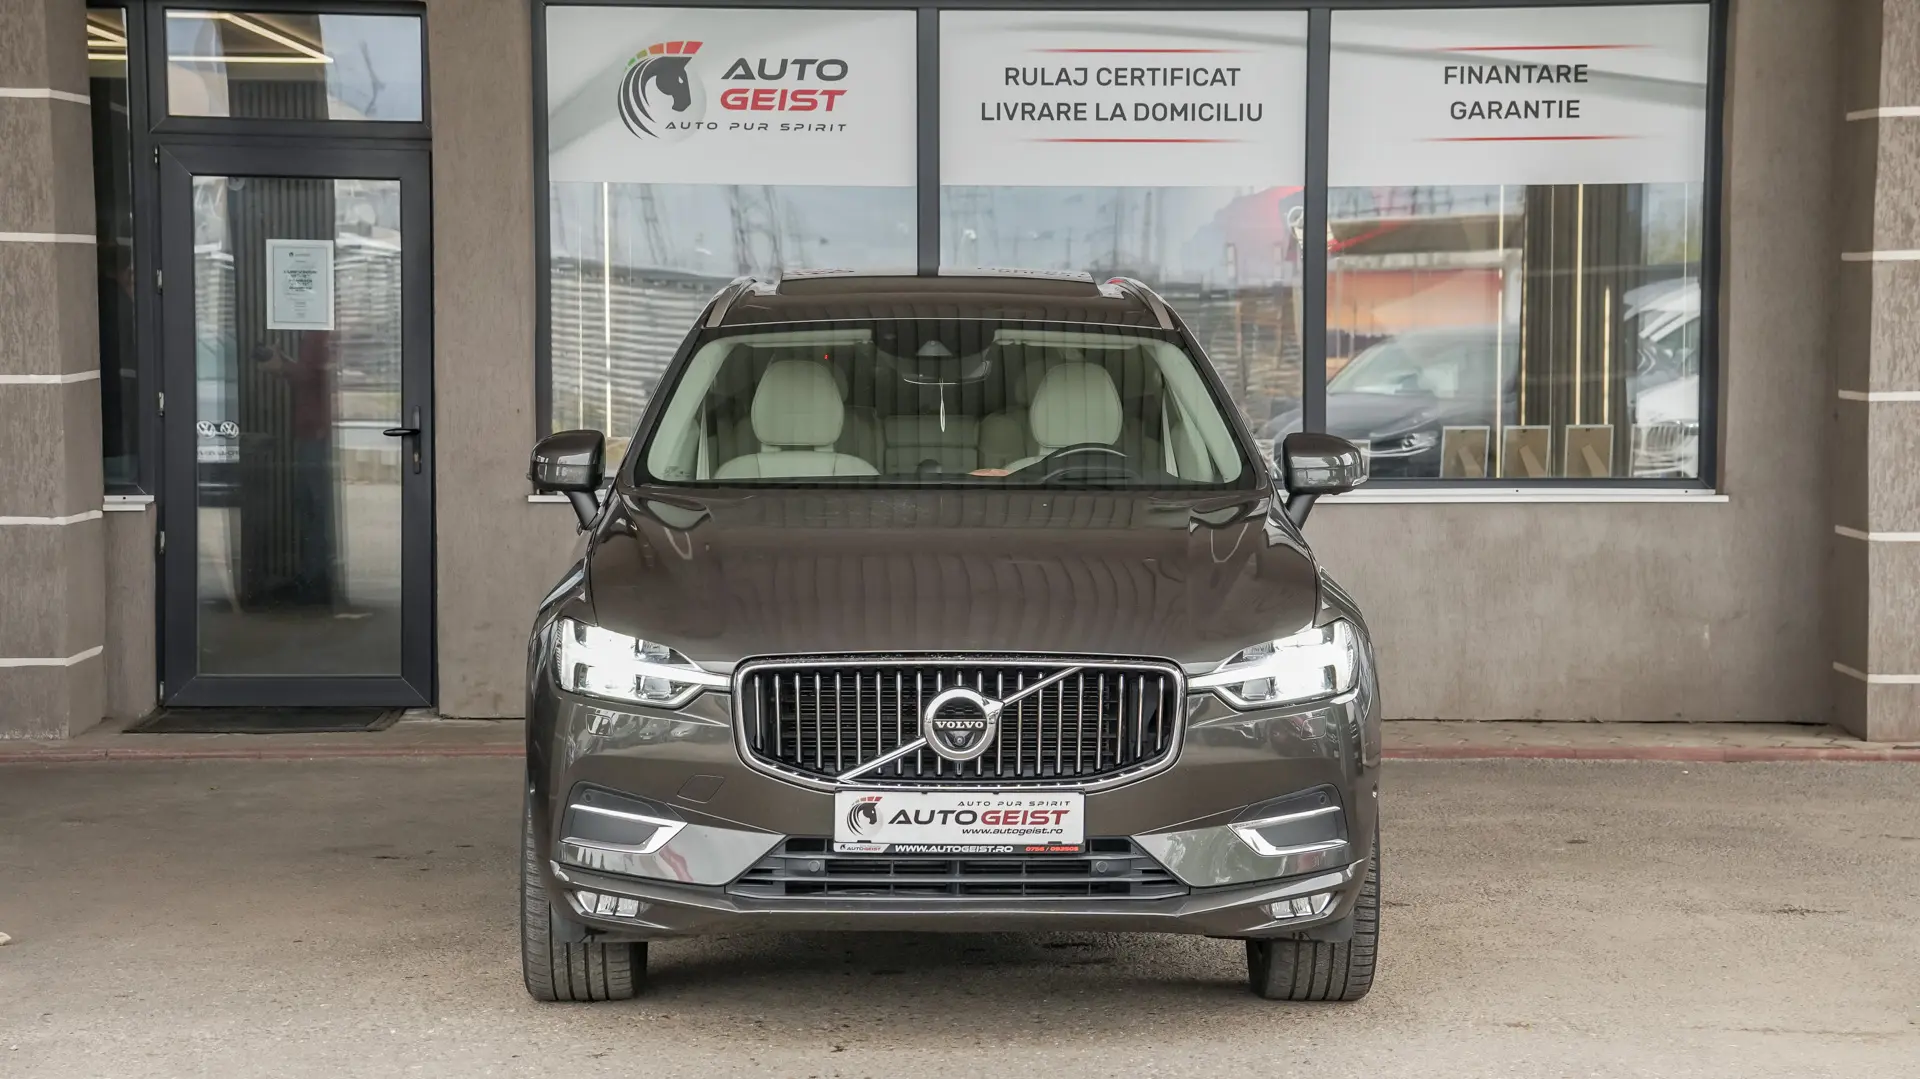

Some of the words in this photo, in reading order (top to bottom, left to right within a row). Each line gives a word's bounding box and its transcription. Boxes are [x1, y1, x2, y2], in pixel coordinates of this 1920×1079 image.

[720, 57, 849, 82] AUTO
[1004, 66, 1088, 87] RULAJ
[1096, 66, 1242, 87] CERTIFICAT
[1444, 63, 1588, 85] FINANTARE
[720, 88, 848, 112] GEIST
[1450, 99, 1581, 120] GARANTIE
[981, 102, 1088, 122] LIVRARE
[1095, 102, 1127, 122] LA
[1133, 102, 1263, 122] DOMICILIU
[665, 121, 718, 130] AUTO
[729, 122, 769, 131] PUR
[779, 123, 847, 132] SPIRIT
[934, 721, 984, 729] VOLVO
[887, 808, 1071, 826] AUTOGEIST
[962, 827, 1064, 837] www.autogeist.ro
[894, 845, 1014, 853] WWW.AUTOGEIST.RO
